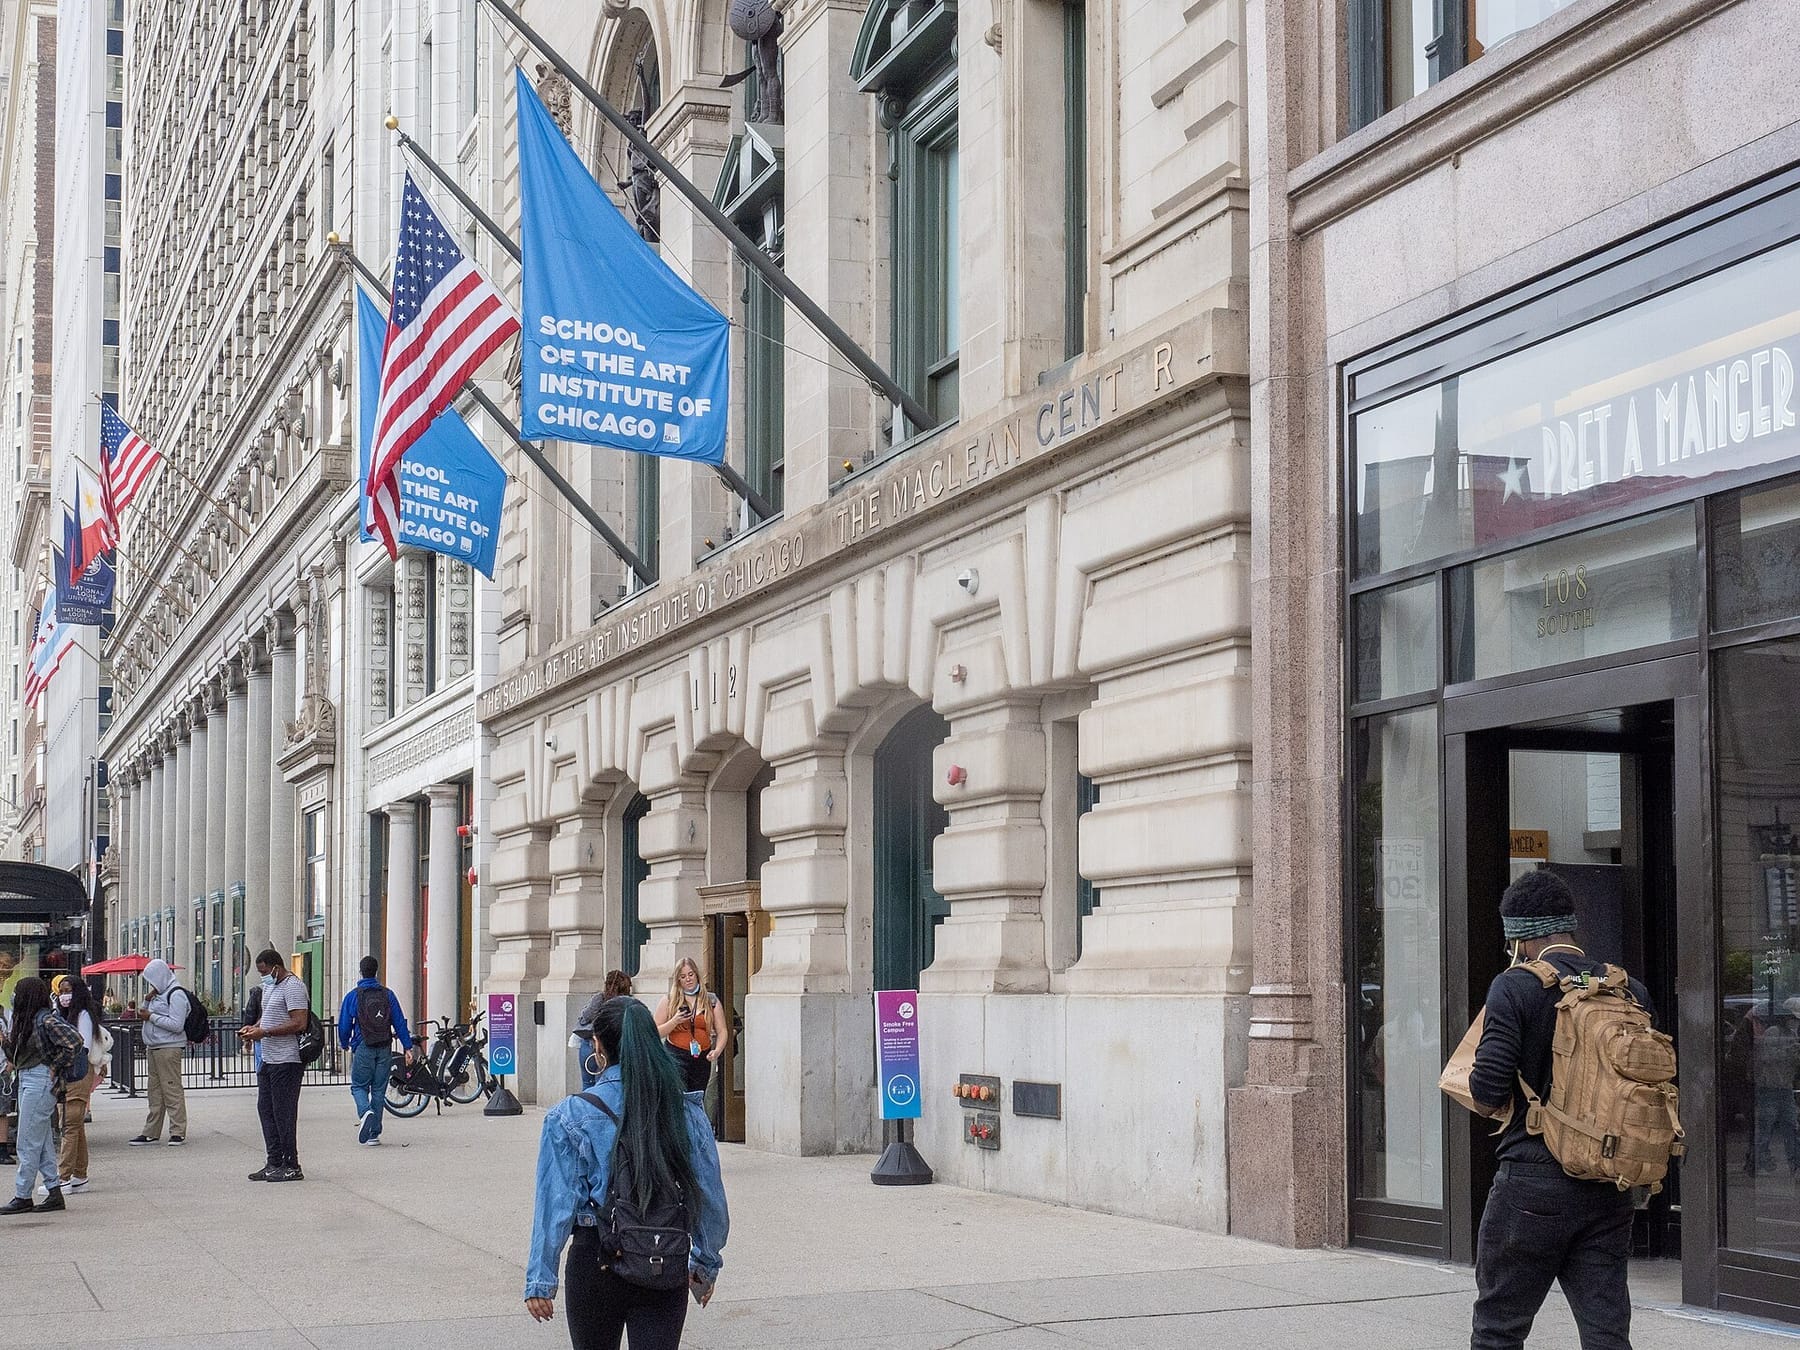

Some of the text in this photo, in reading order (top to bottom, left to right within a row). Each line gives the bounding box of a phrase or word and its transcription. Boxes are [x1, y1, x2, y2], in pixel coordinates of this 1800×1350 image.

[540, 315, 646, 351] SCHOOL
[540, 345, 691, 386] OF THE ART
[539, 373, 711, 417] INSTITUTE OF
[538, 403, 656, 439] CHICAGO
[1542, 347, 1795, 500] PRET A MANGER
[400, 460, 450, 485] HOOL
[837, 490, 881, 544] THE
[891, 418, 1021, 518] MACLEAN
[403, 480, 479, 513] THE ART
[400, 519, 456, 546] ICAGO
[470, 521, 490, 538] OF
[1543, 564, 1587, 608] 108
[482, 531, 804, 716] THE SCHOOL OF THE ART INSTITUTE OF CHICAGO
[1537, 607, 1594, 638] SOUTH
[694, 664, 737, 711] 112
